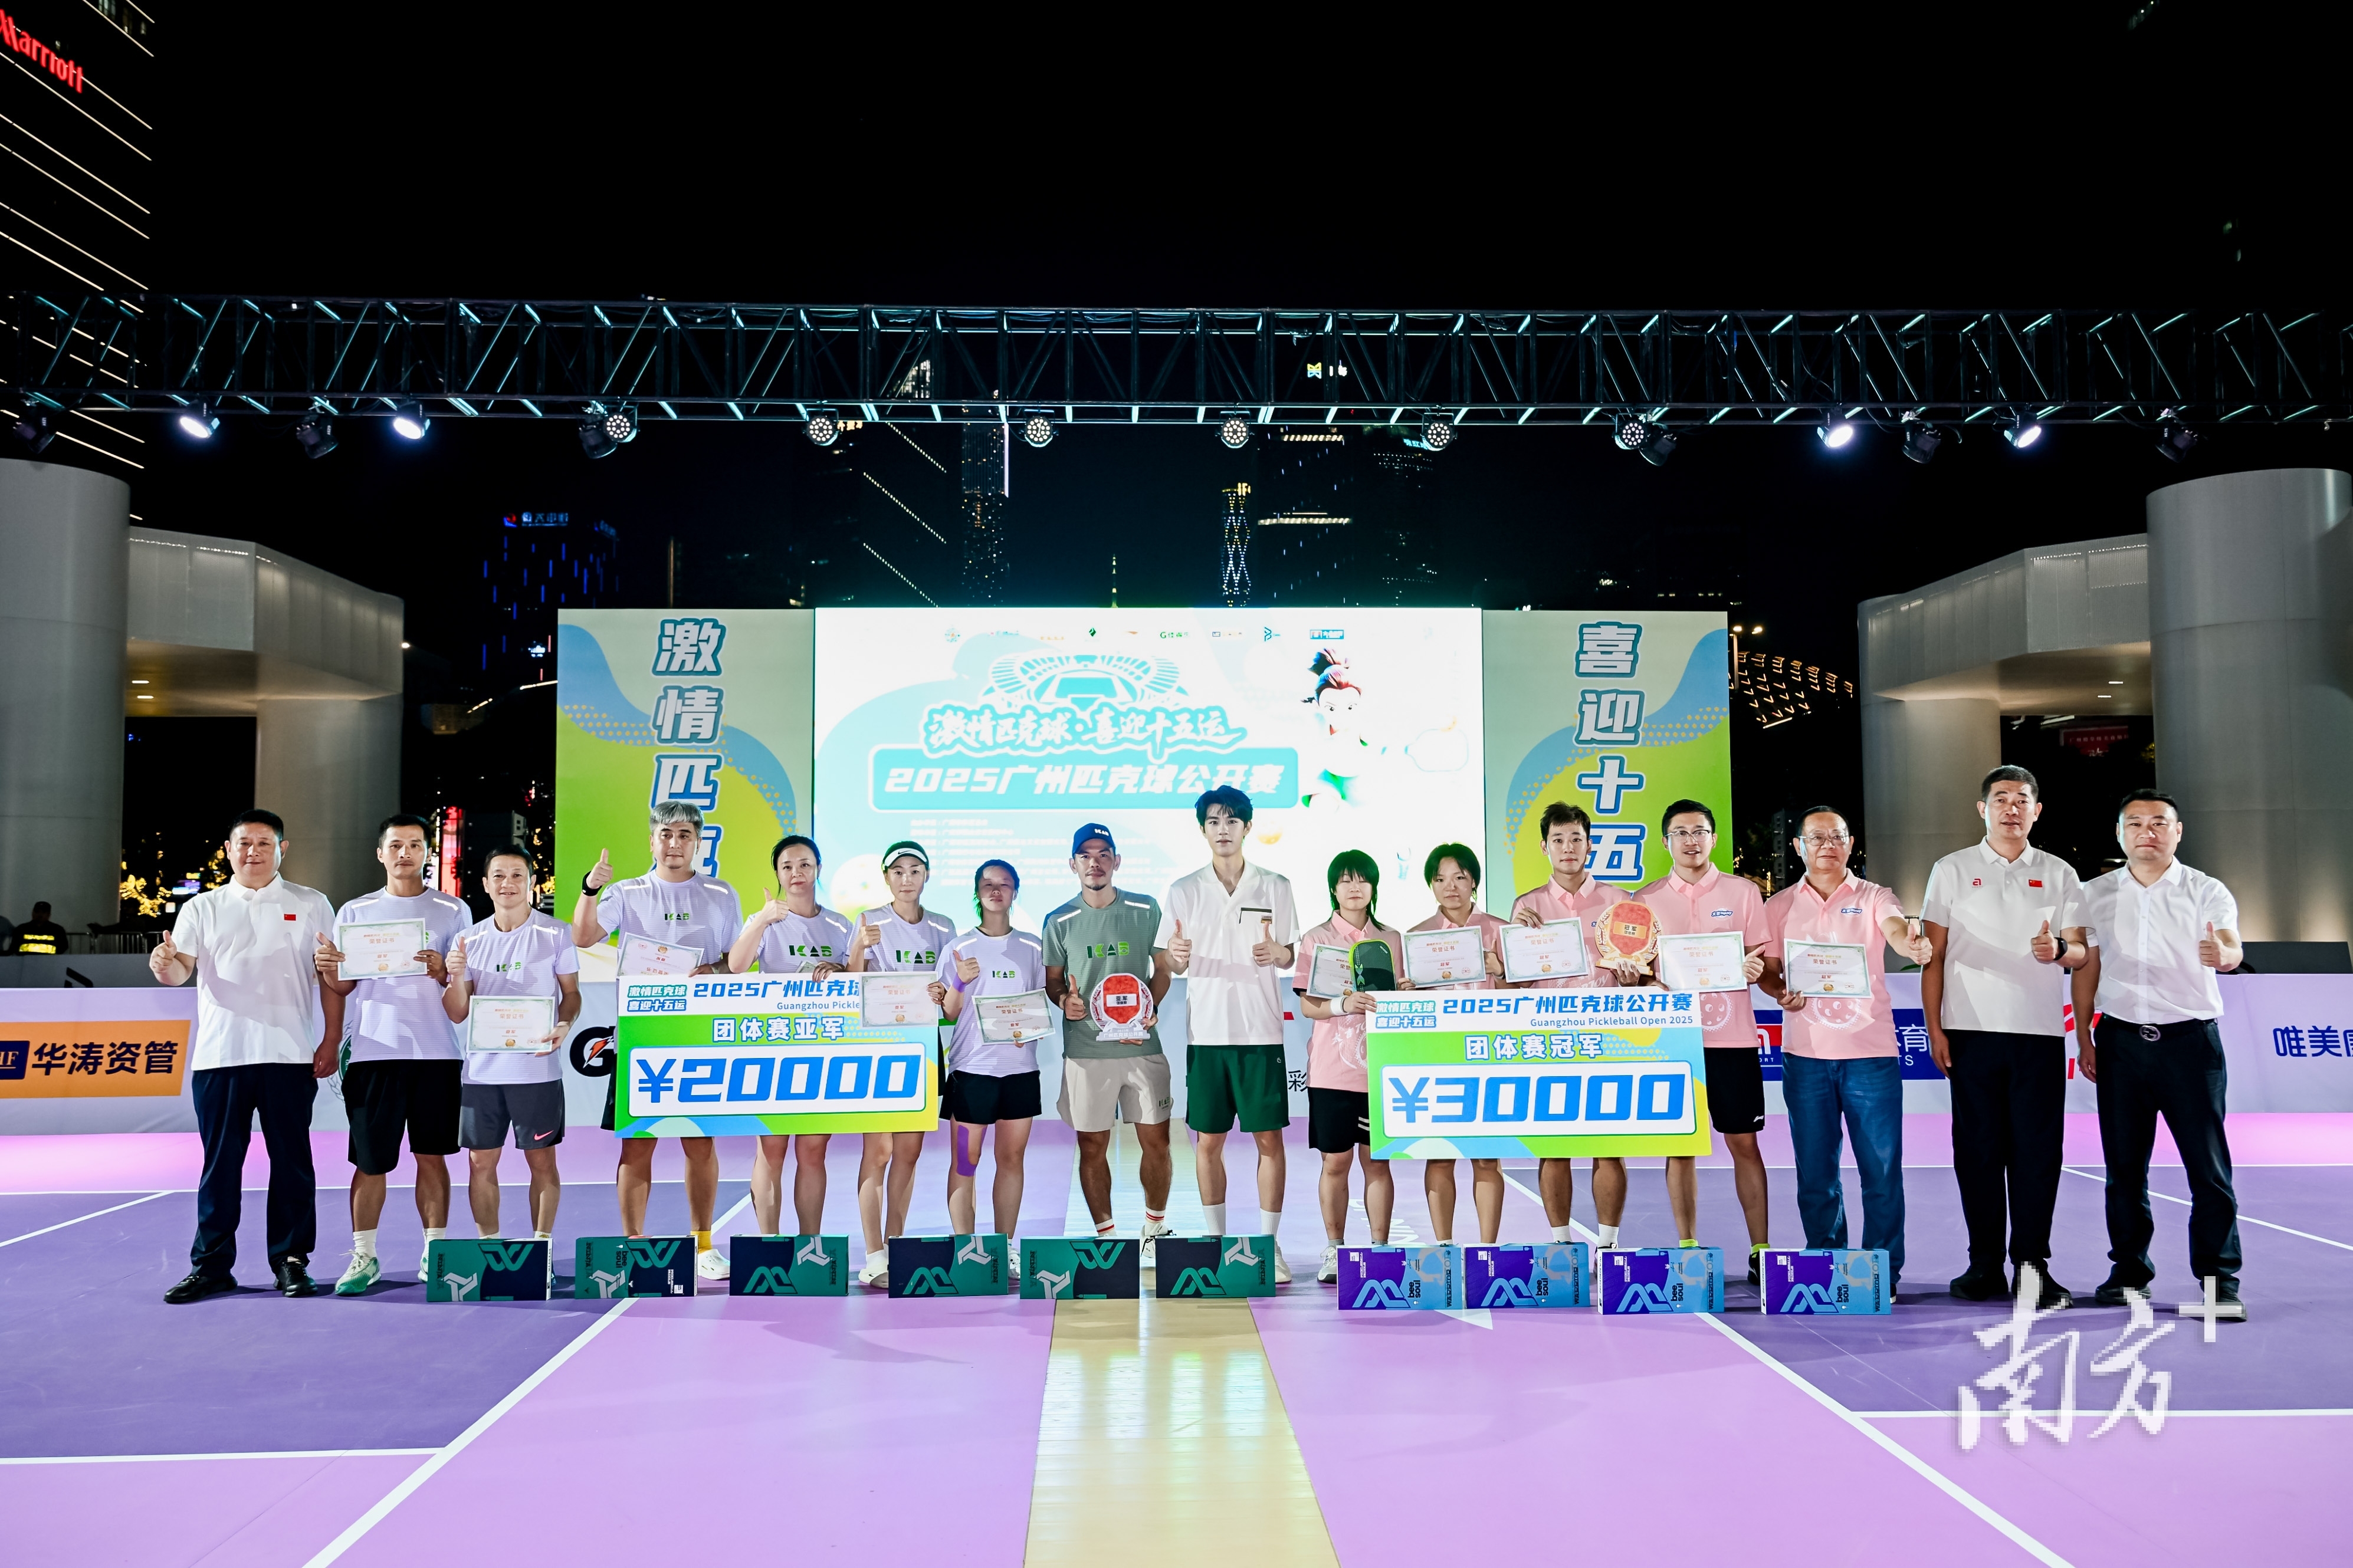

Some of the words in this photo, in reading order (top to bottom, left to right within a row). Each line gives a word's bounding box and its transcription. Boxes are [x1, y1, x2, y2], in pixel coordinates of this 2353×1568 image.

[0, 9, 83, 94] Marriott
[885, 764, 1285, 795] 2025广州匹克球公开赛
[628, 985, 687, 998] 激情匹克球
[627, 999, 687, 1012] 喜迎十五运
[777, 1001, 830, 1011] Guangzhou
[1376, 1001, 1435, 1014] 激情匹克球
[1443, 993, 1692, 1015] 2025广州匹克球公开赛
[713, 1017, 845, 1043] 团体赛亚军
[1376, 1015, 1436, 1028] 喜迎十五运
[1530, 1017, 1586, 1028] Guangzhou
[1589, 1016, 1638, 1026] Pickleball
[1640, 1016, 1667, 1027] Open
[1670, 1015, 1693, 1025] 2025
[32, 1041, 178, 1076] 华涛资管
[1465, 1034, 1603, 1060] 团体赛冠军
[636, 1055, 921, 1103] ¥20000
[1388, 1074, 1685, 1124] ¥30000
